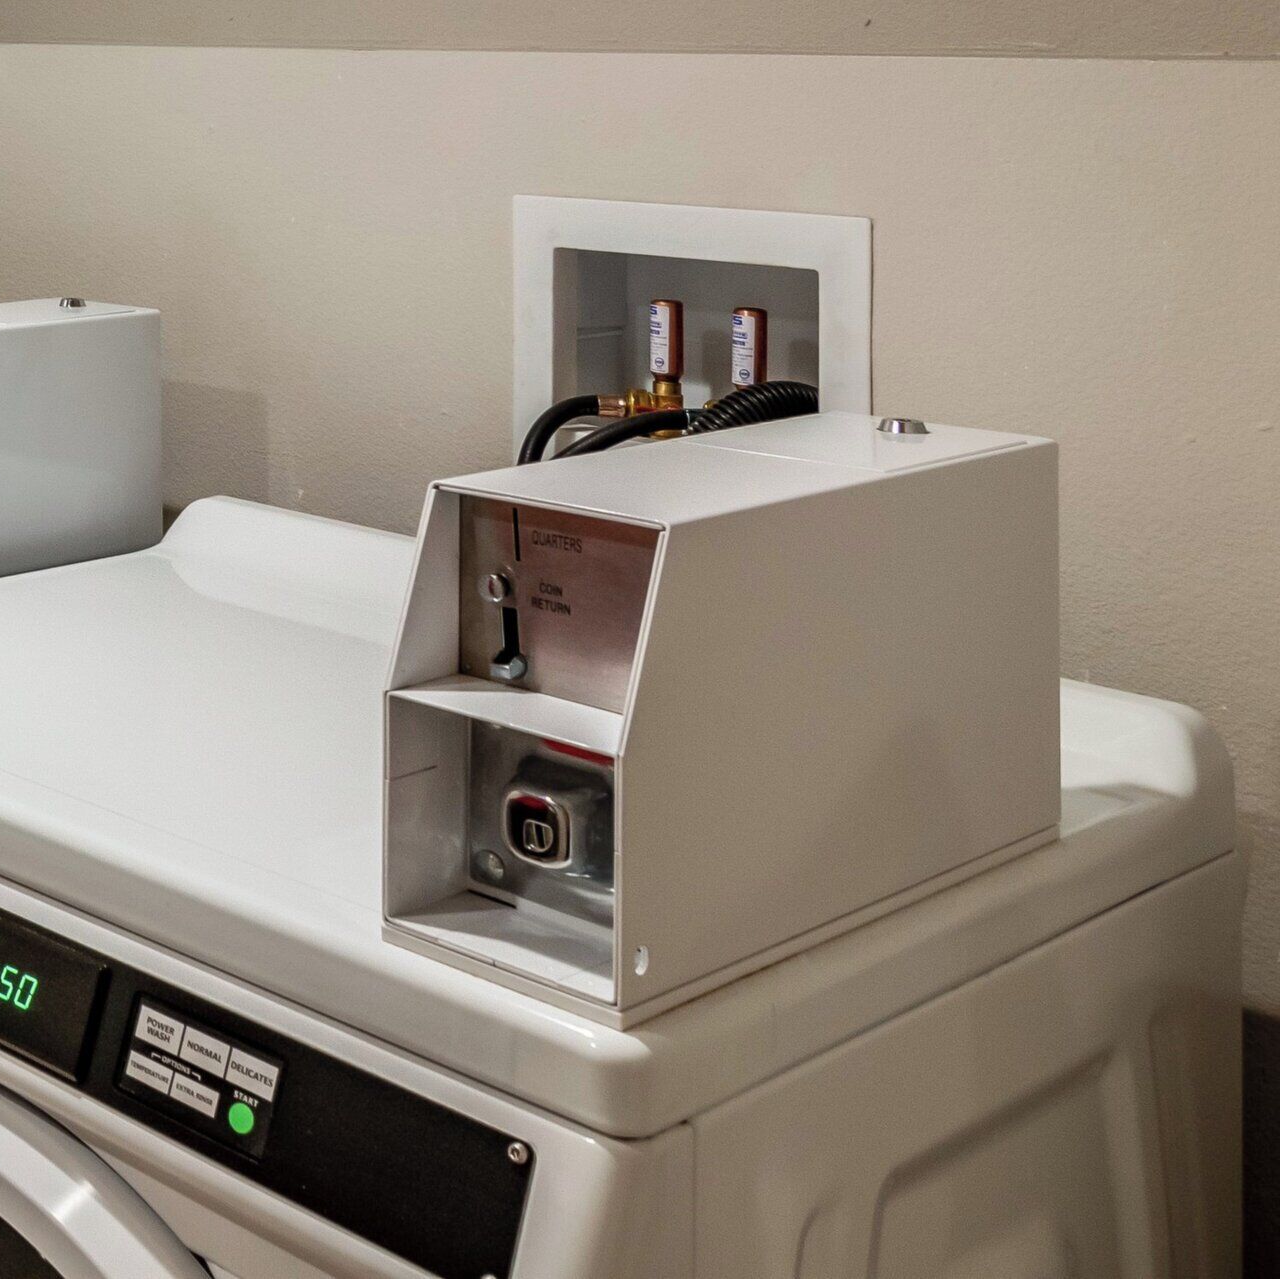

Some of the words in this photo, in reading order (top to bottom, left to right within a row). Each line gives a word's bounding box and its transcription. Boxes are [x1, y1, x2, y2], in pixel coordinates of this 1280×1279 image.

[532, 530, 583, 553] QUARTERS
[539, 581, 563, 597] COIN
[531, 598, 572, 616] RETURN
[146, 1015, 175, 1036] POWER
[146, 1026, 171, 1044] WASH
[186, 1040, 222, 1064] NORMAL
[230, 1060, 274, 1088] DELICATES
[233, 1089, 259, 1108] START
